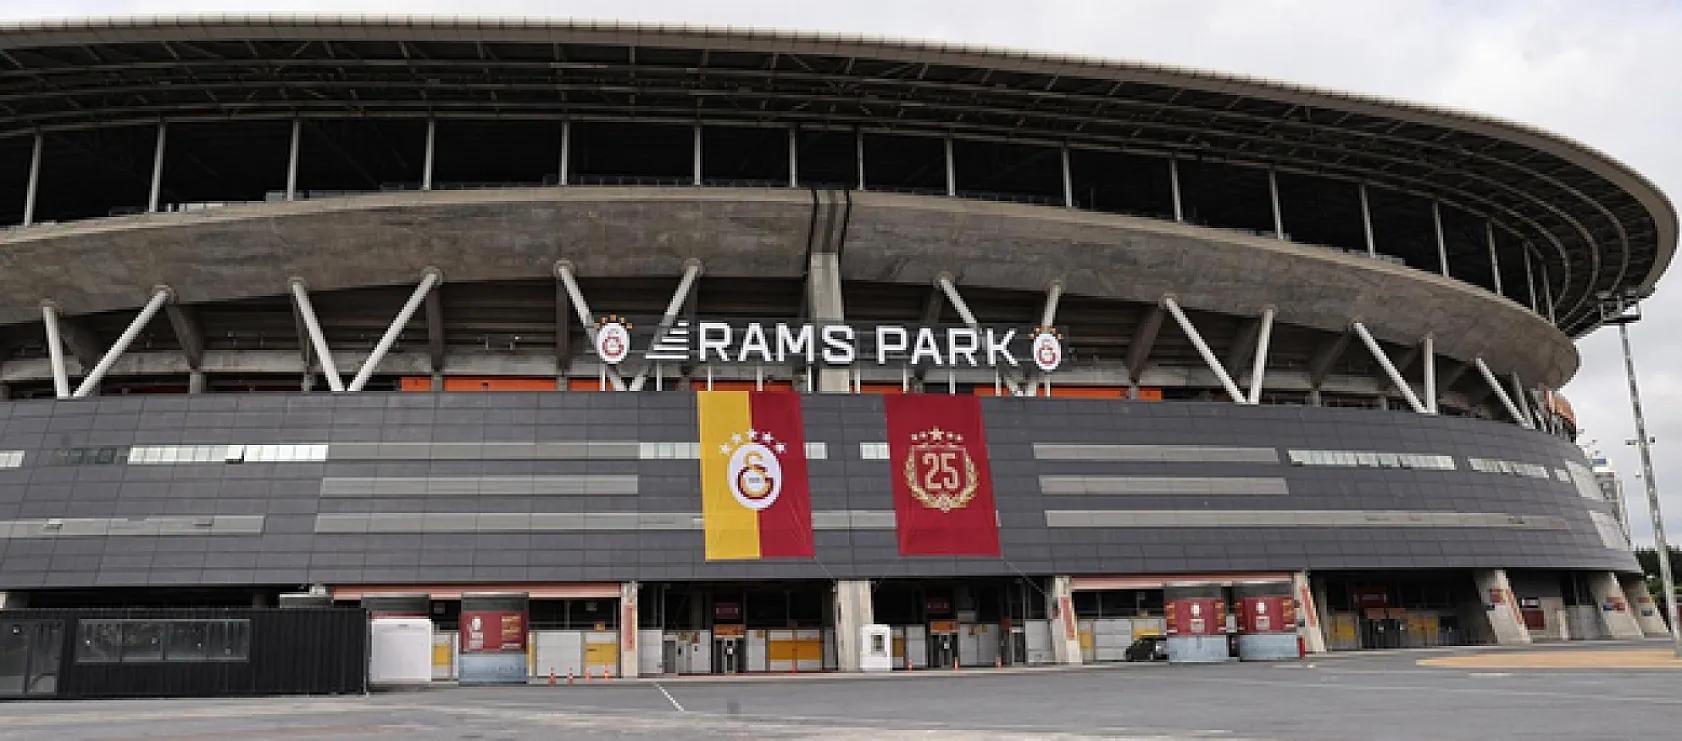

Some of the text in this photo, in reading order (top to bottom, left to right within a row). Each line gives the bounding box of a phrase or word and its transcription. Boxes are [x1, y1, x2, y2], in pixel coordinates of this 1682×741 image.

[699, 322, 855, 362] RAMS
[877, 325, 1018, 366] PARK
[922, 453, 960, 489] 25
